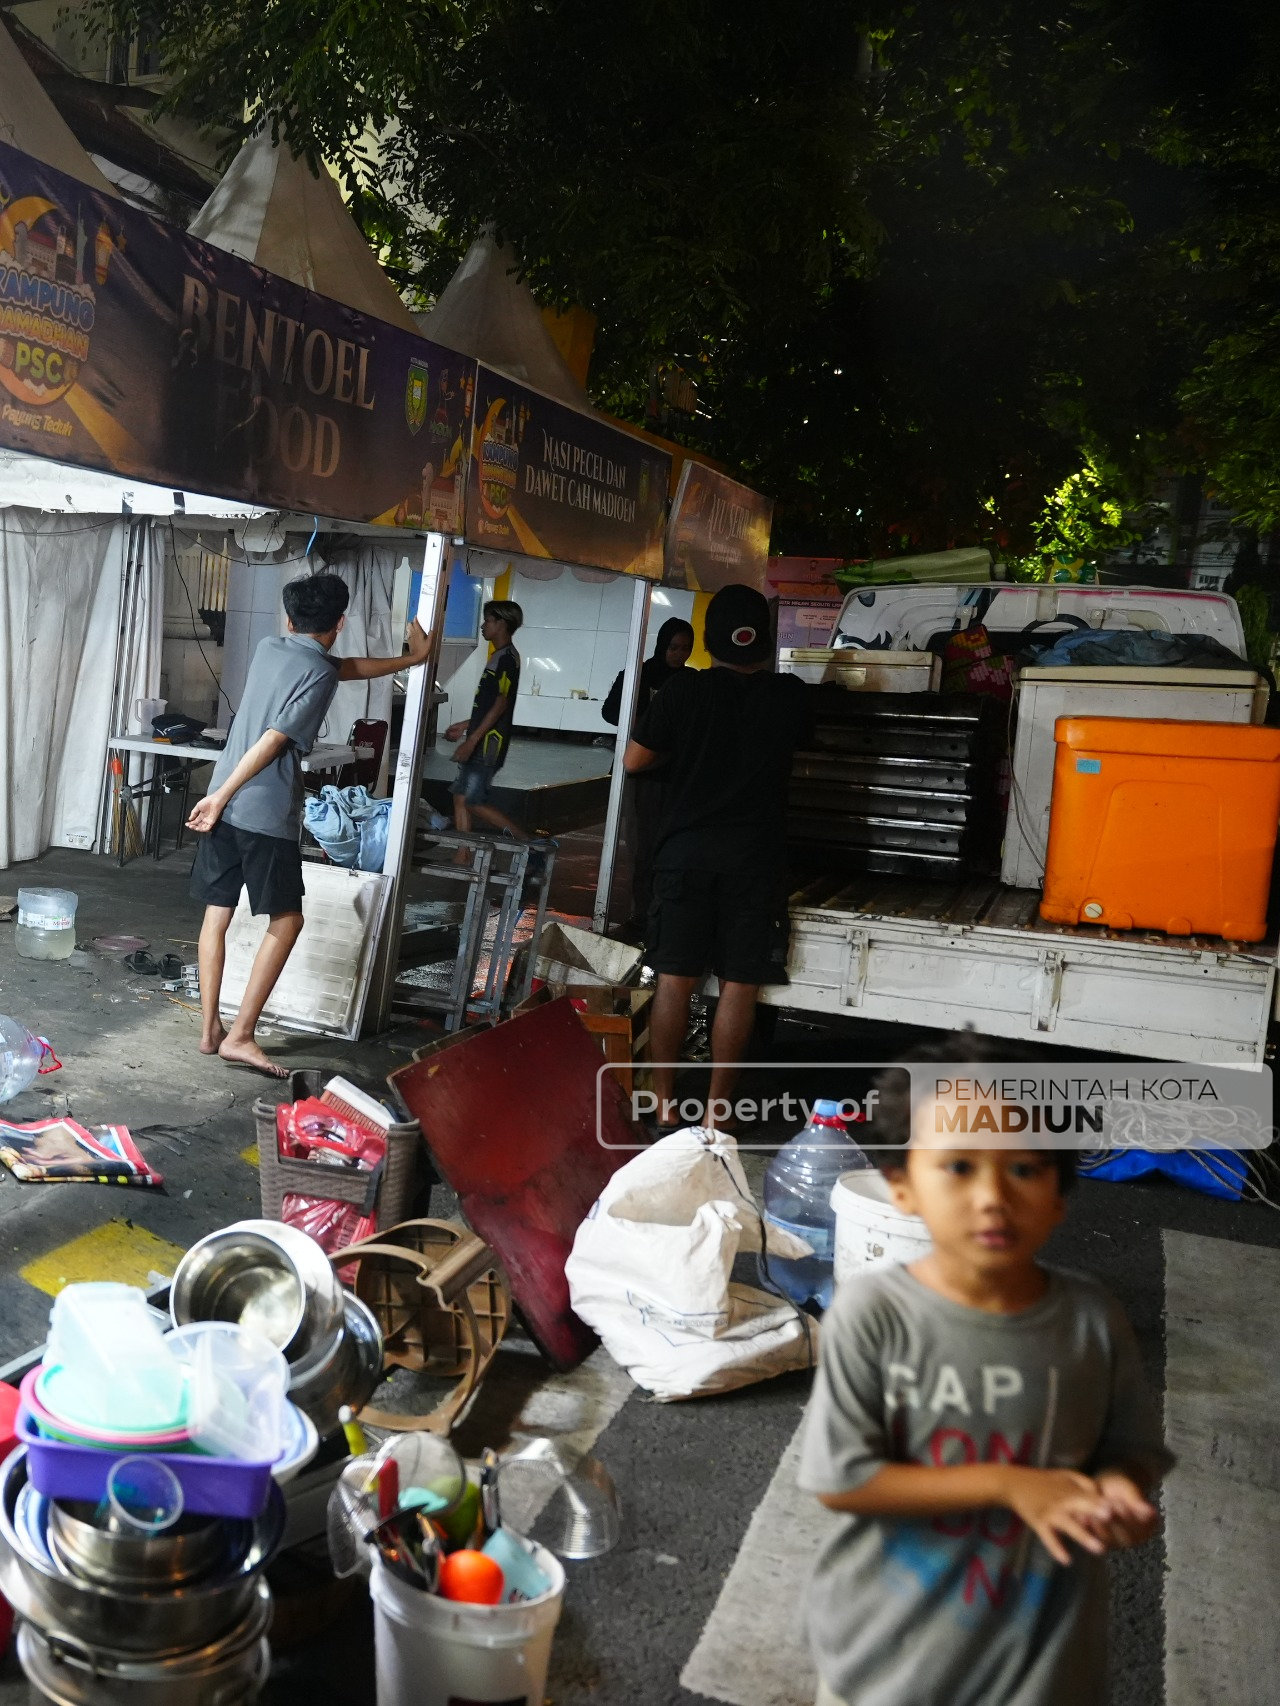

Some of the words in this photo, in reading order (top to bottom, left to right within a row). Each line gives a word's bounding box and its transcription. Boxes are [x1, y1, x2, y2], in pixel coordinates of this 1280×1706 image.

[15, 341, 63, 383] PSC
[182, 274, 376, 411] BENTOEL
[542, 428, 571, 471] NASI
[573, 446, 605, 483] PECEL
[606, 460, 626, 489] DAN
[525, 464, 567, 503] DAWET
[568, 479, 591, 511] CAH
[592, 489, 636, 523] MADIOEN
